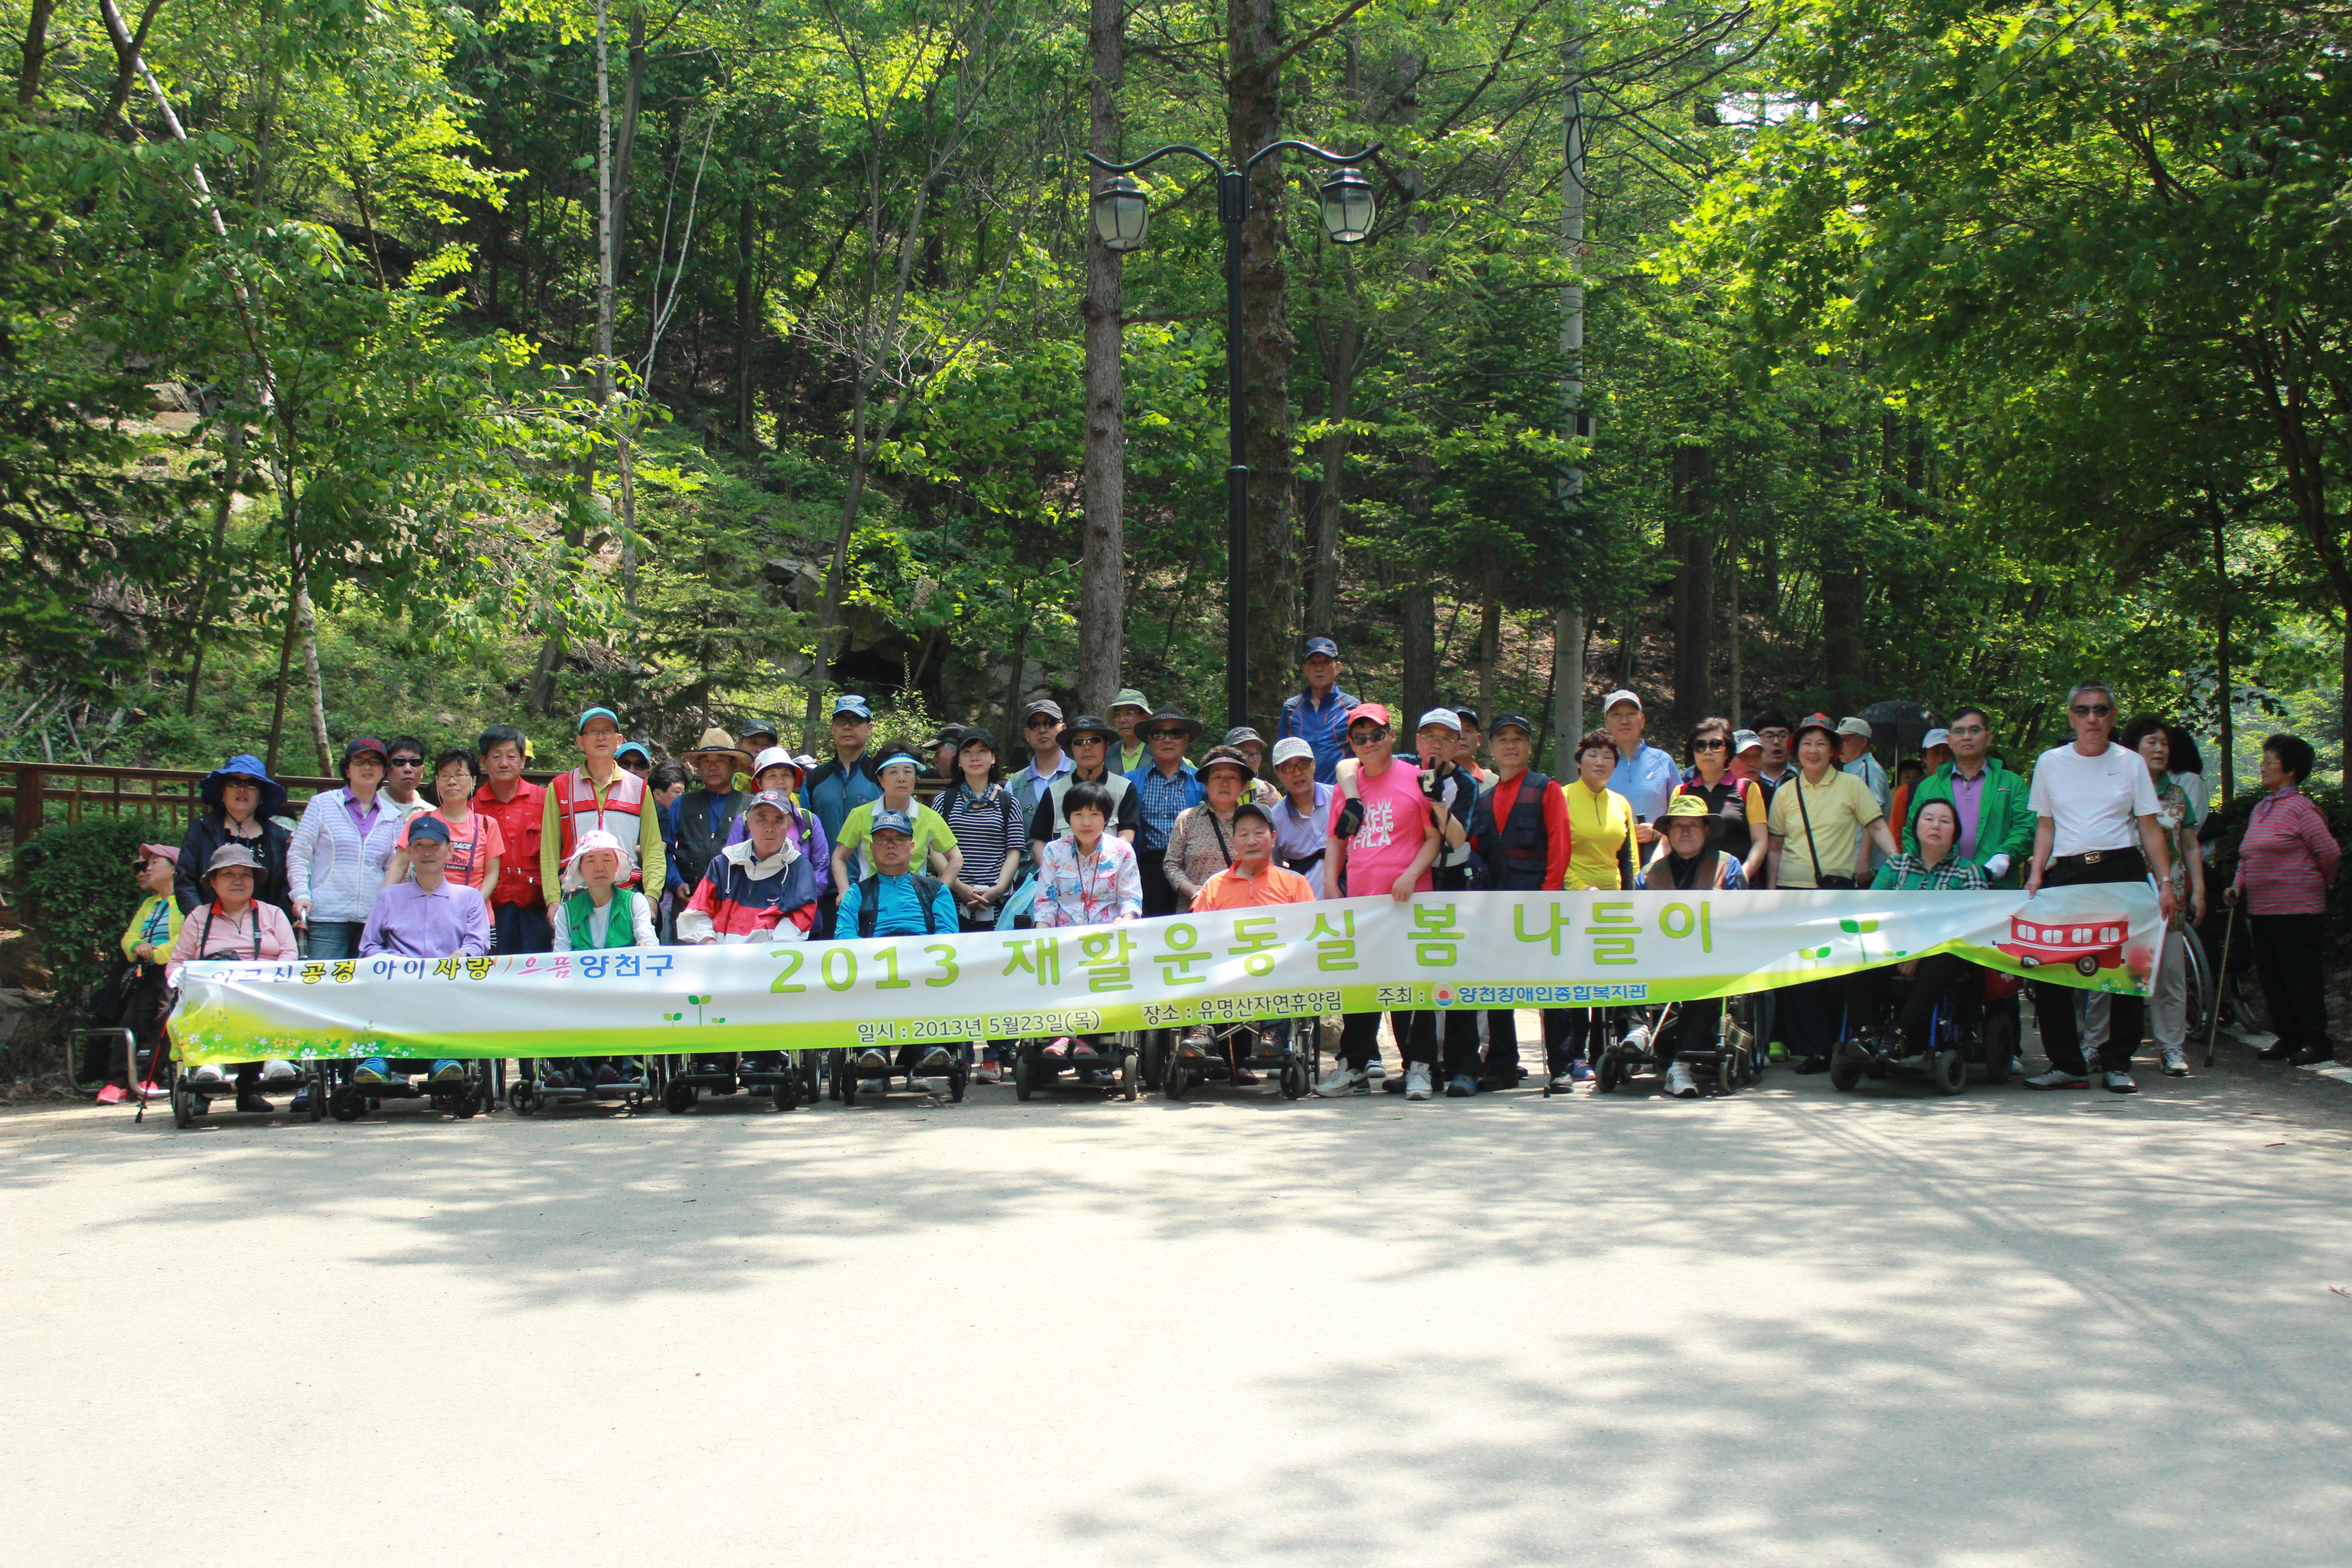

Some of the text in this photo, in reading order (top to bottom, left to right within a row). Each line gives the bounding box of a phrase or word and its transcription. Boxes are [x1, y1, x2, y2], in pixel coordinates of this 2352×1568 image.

[1353, 831, 1392, 850] FILA
[770, 901, 1712, 994] 2013 재활운동실 봄 나들이
[914, 1018, 982, 1038] 2013년
[990, 1009, 1100, 1036] 5월23일(목)
[1198, 991, 1341, 1020] 유명산자연휴양림
[1459, 984, 1647, 1004] 양천장애인종합복지관
